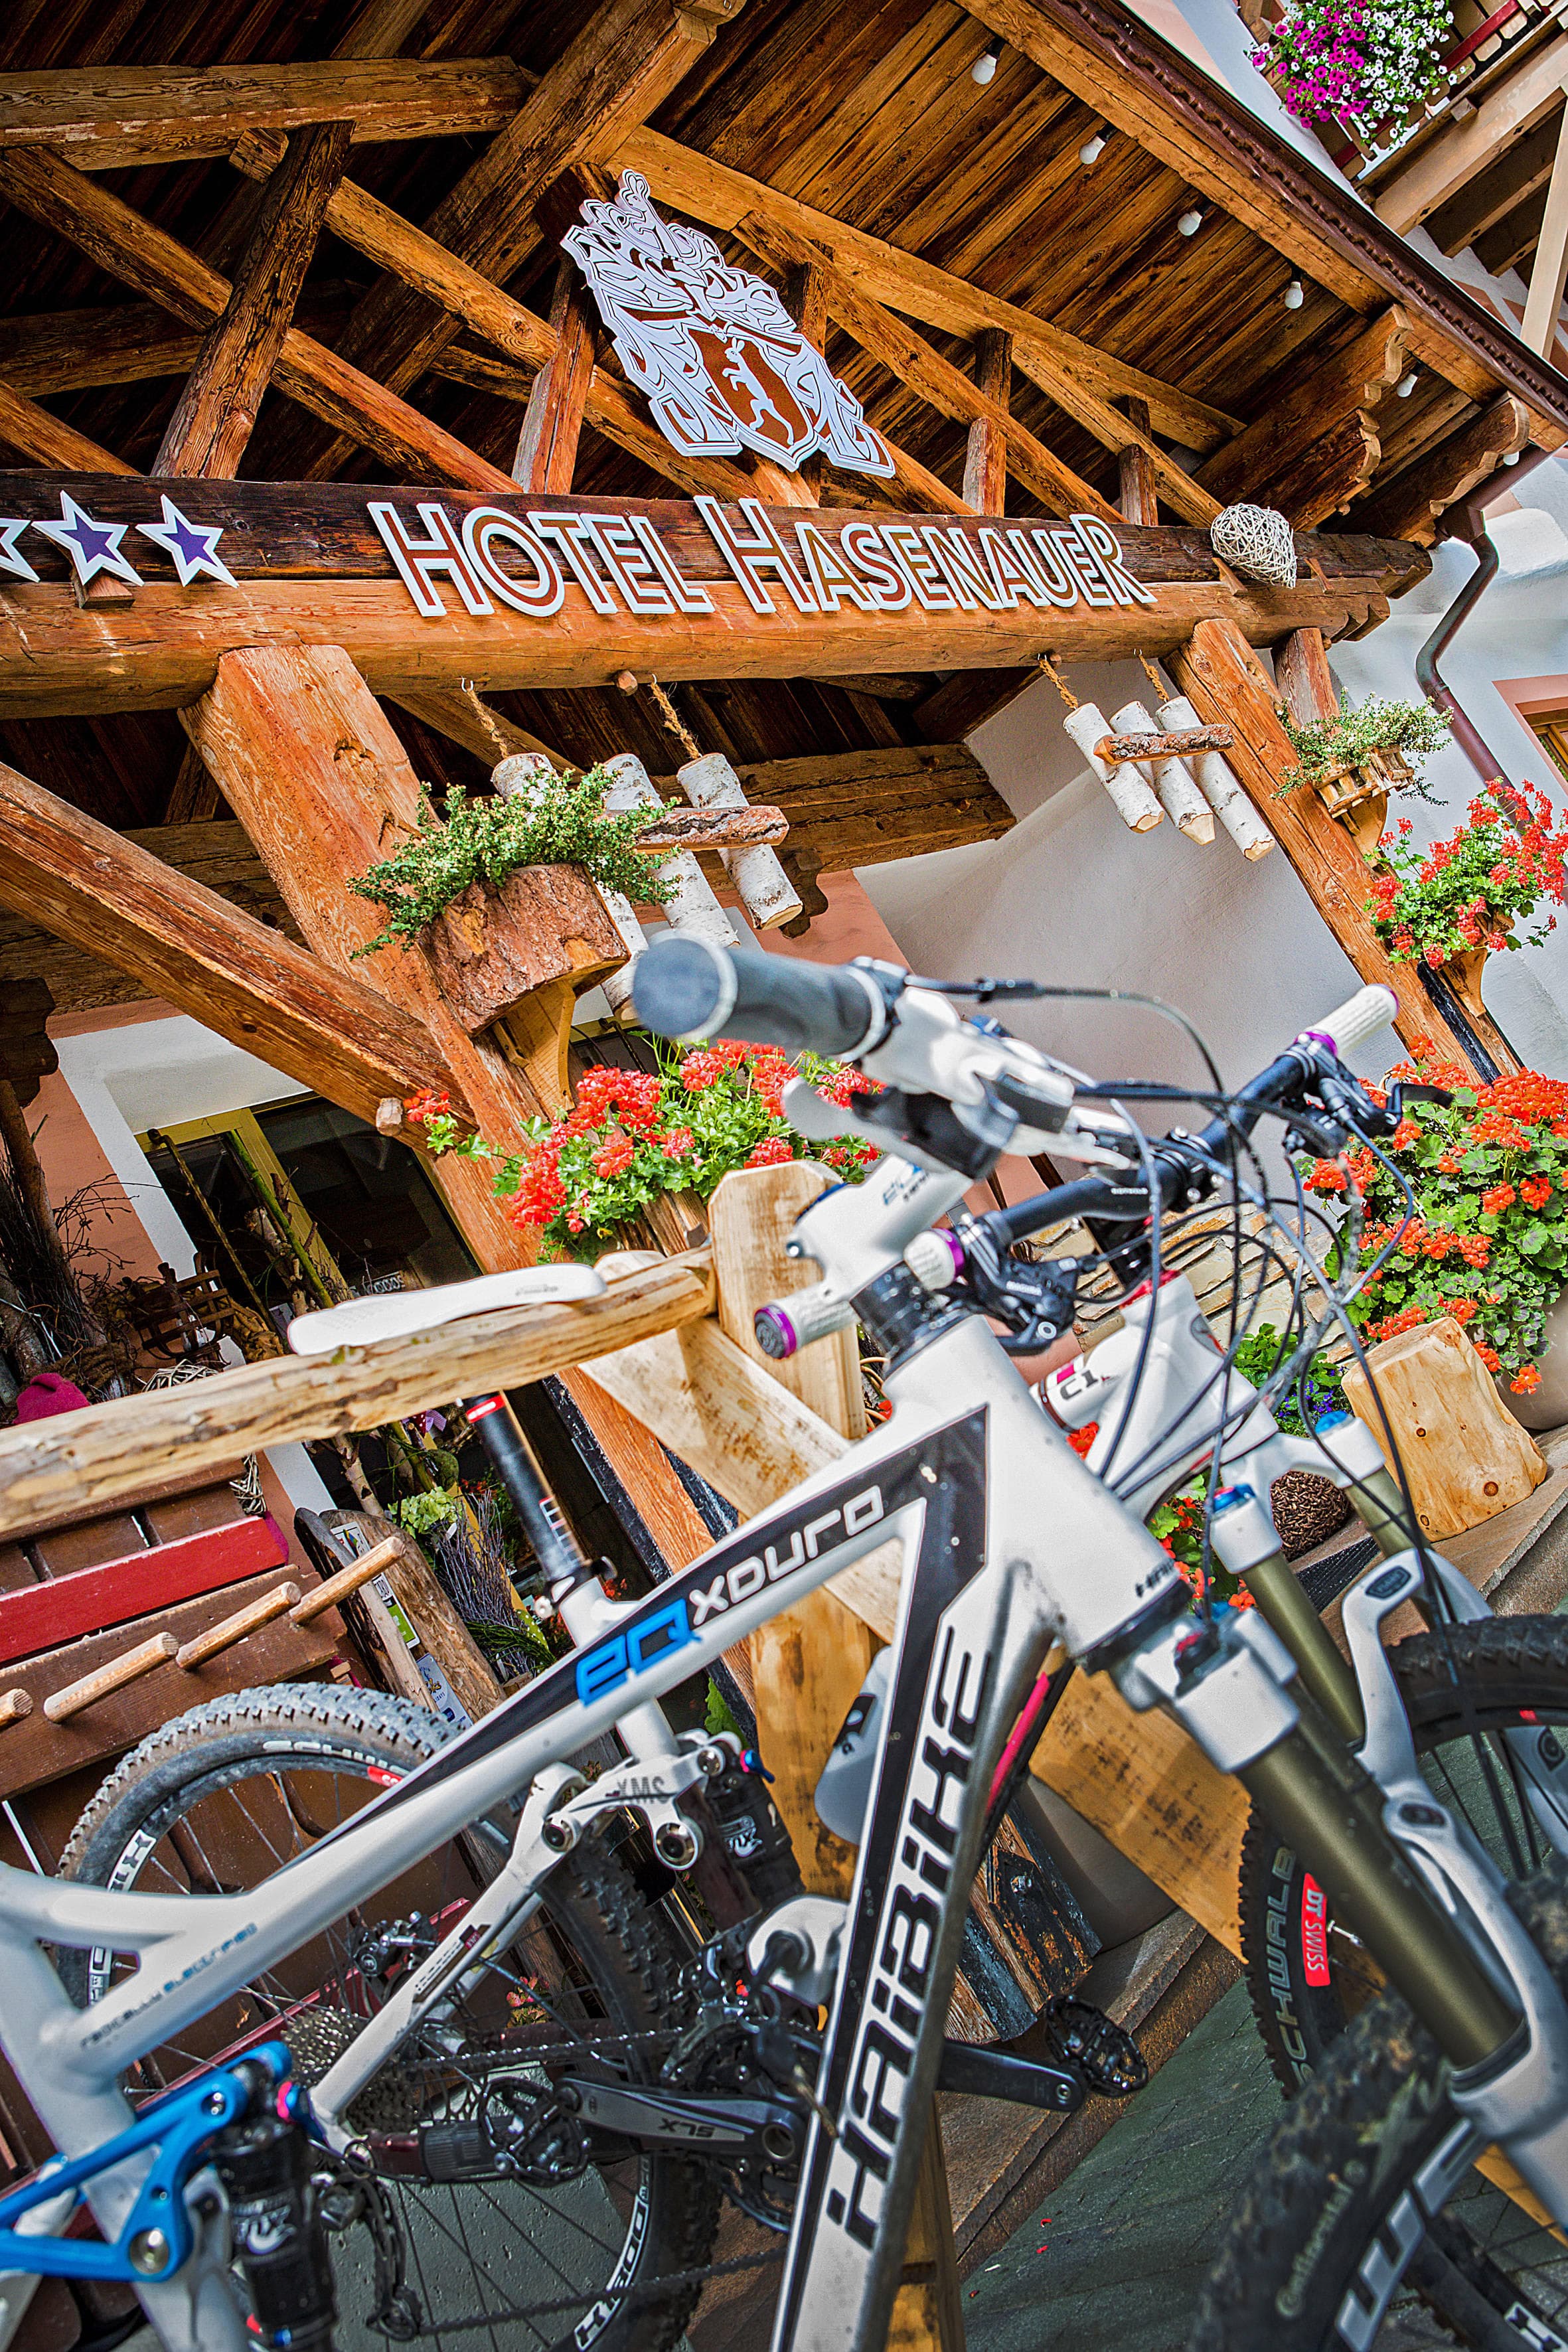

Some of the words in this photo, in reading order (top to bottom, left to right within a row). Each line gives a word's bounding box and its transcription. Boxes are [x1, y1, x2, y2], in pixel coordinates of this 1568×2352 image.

[367, 502, 715, 617] HOTEL
[693, 495, 1158, 613] HASENAUER
[1305, 1889, 1325, 1919] DT
[1267, 1846, 1316, 2085] SCHWALB
[1305, 1919, 1326, 1971] SWISS
[660, 2116, 715, 2138] SLX
